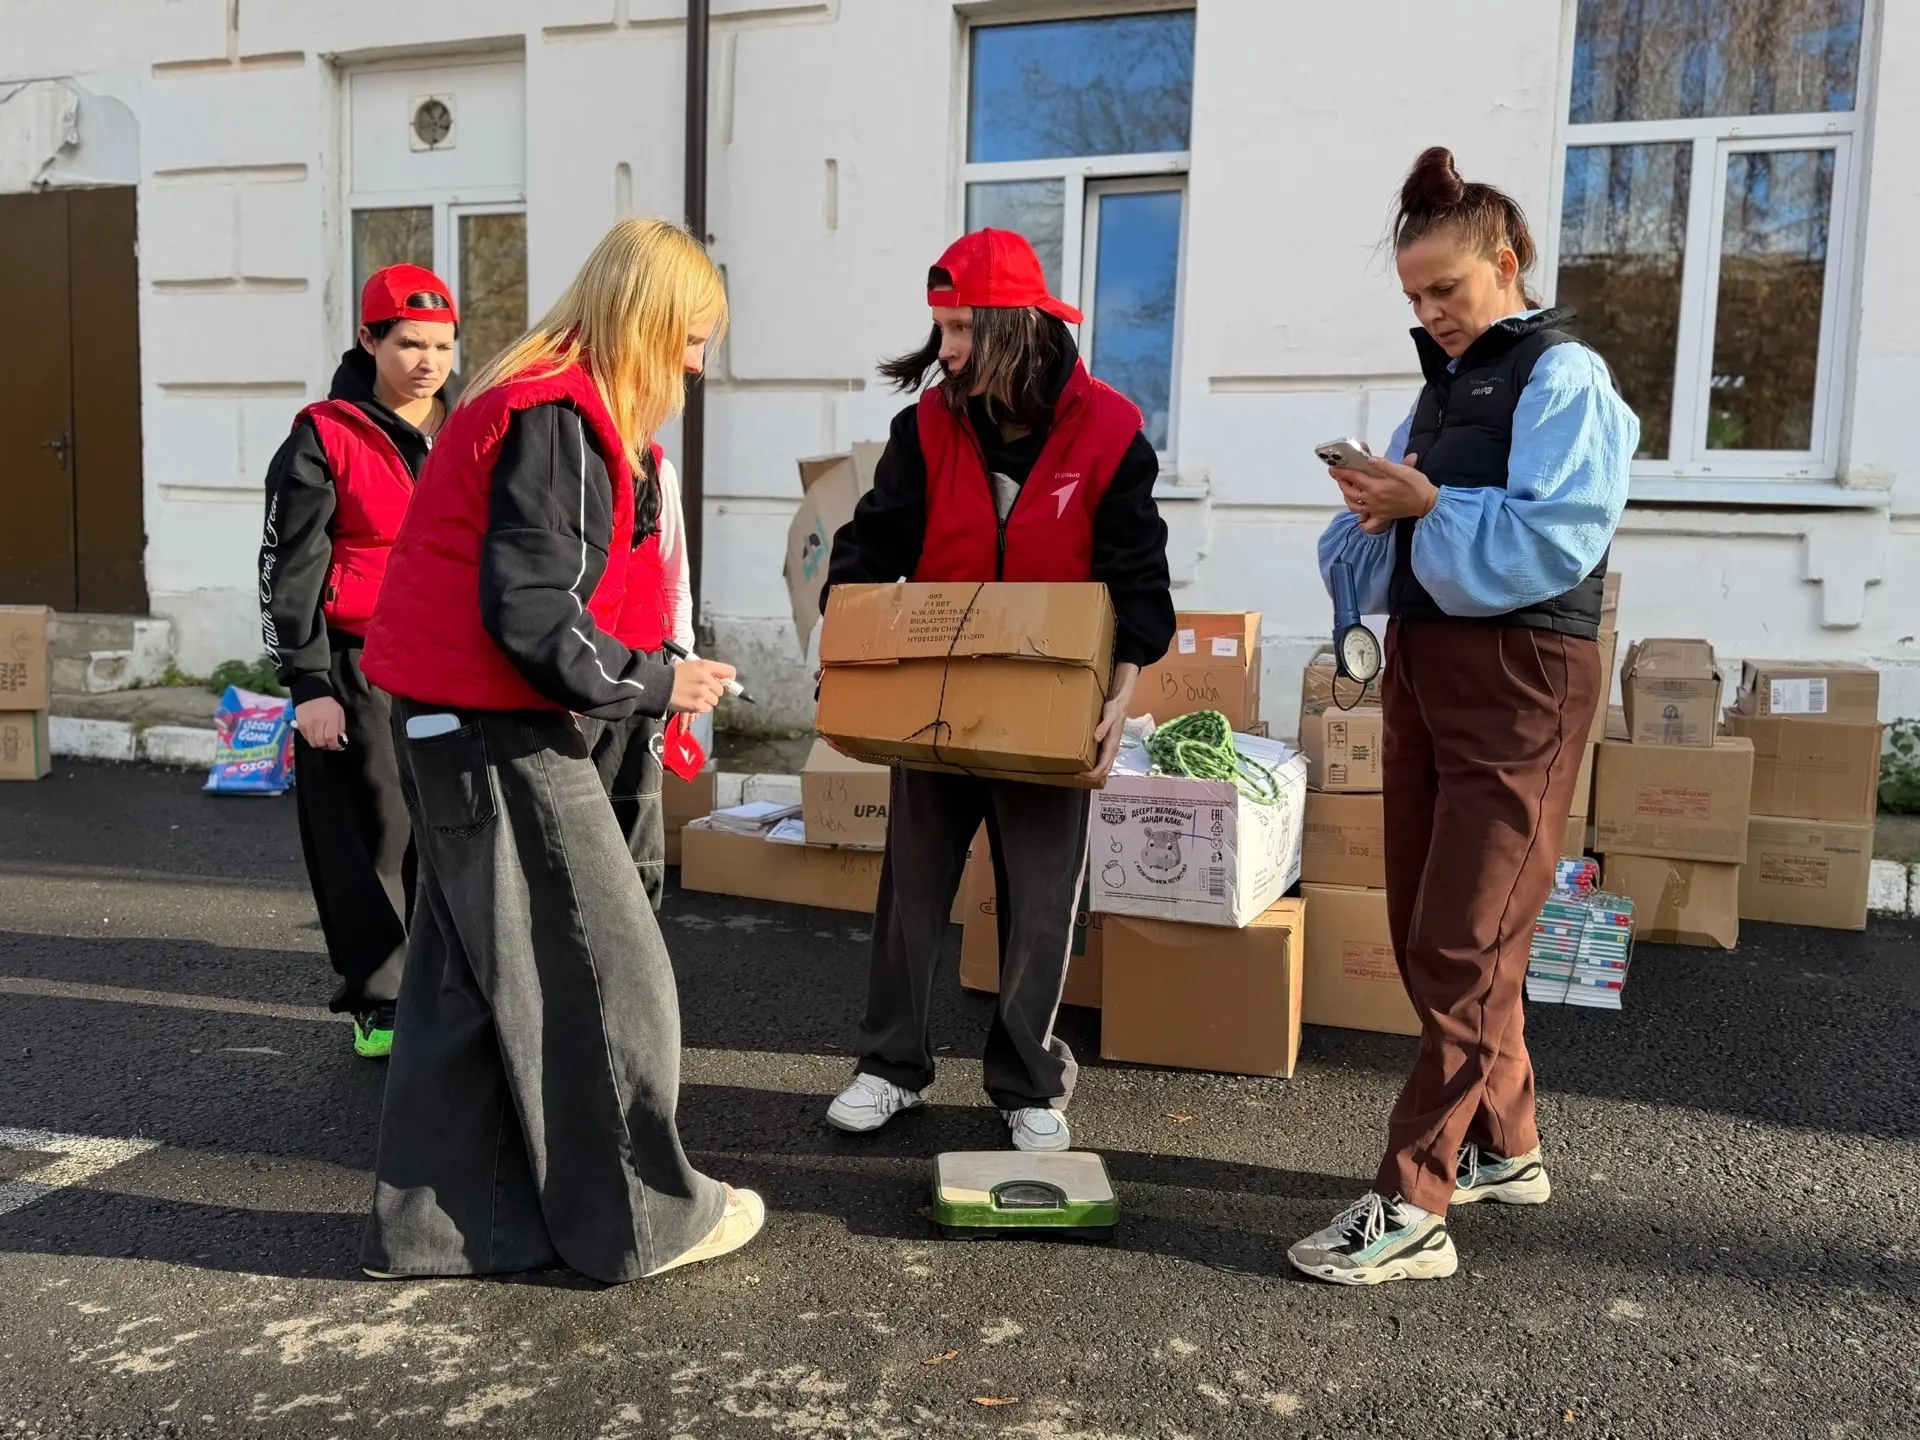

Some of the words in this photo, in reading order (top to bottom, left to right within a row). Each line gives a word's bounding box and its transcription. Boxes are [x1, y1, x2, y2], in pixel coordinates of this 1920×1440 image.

[1160, 673, 1178, 699] 13
[854, 805, 887, 818] UPA
[1131, 807, 1153, 818] ДЕСЕРТ
[1154, 806, 1193, 820] ЖЕЛЕЙНЫЙ
